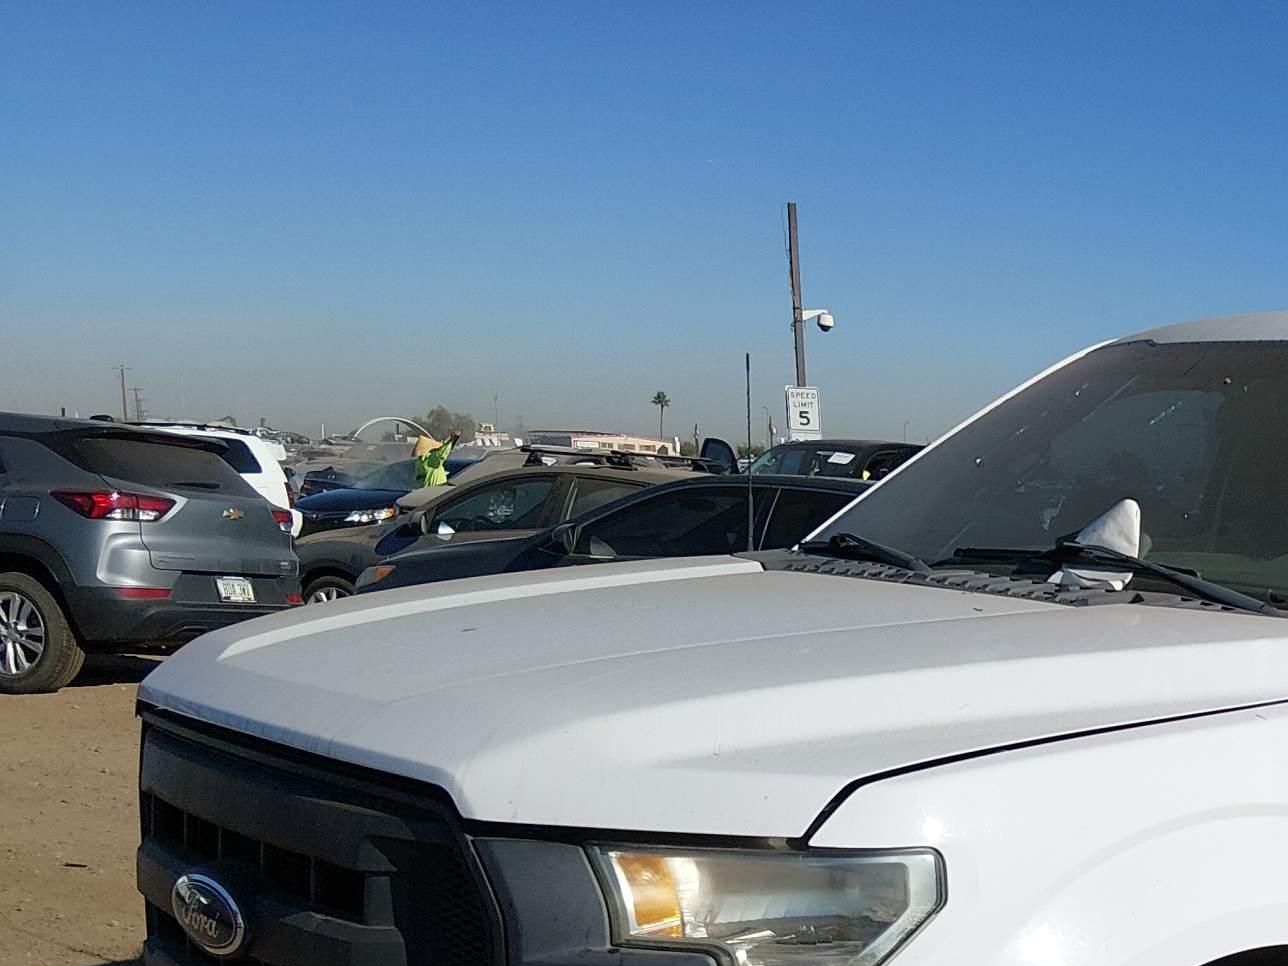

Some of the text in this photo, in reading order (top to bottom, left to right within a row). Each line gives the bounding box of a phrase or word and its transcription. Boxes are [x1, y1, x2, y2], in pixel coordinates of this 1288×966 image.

[790, 391, 817, 400] SPEED
[793, 401, 814, 409] LIMIT
[798, 410, 811, 426] 5
[182, 888, 220, 938] Ford
